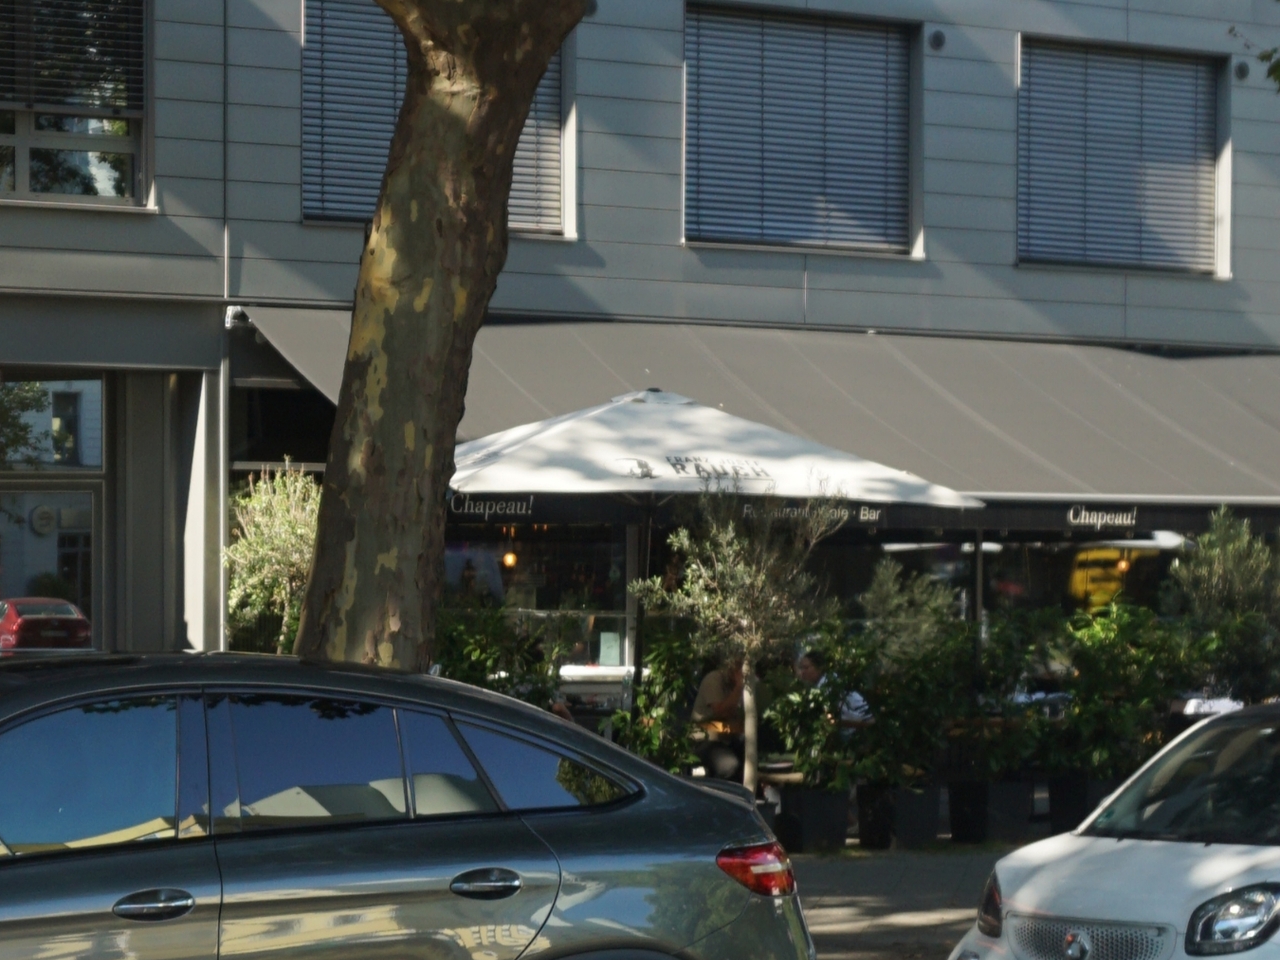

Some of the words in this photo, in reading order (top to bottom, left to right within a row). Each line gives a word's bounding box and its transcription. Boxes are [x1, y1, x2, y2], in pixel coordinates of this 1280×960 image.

[665, 456, 709, 464] FRANZ
[670, 462, 771, 478] RAUCH
[451, 493, 534, 521] Chapeau!
[743, 504, 810, 518] Raurant
[860, 506, 882, 520] Bar
[1067, 505, 1137, 530] Chapeau!
